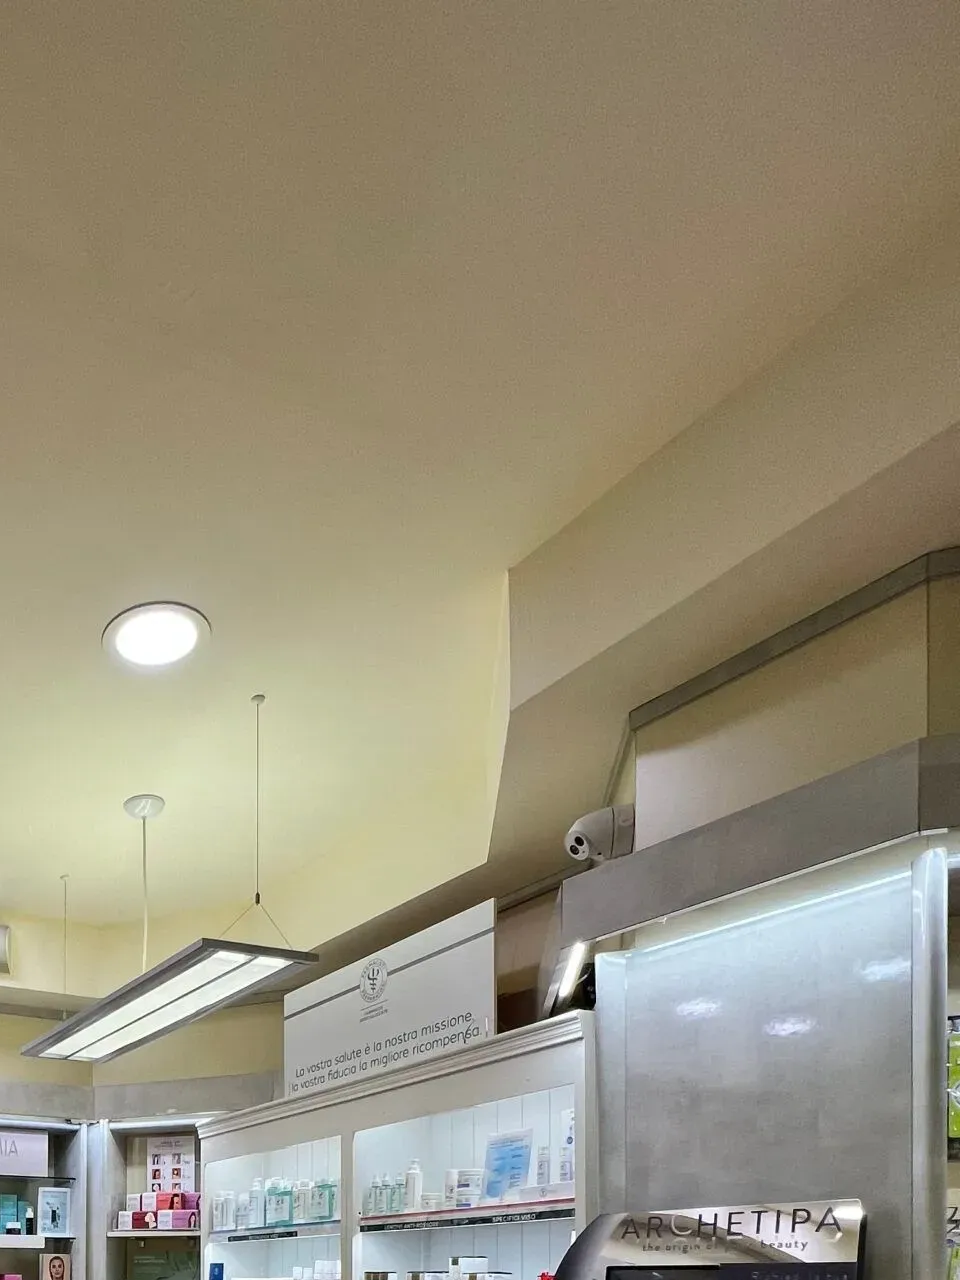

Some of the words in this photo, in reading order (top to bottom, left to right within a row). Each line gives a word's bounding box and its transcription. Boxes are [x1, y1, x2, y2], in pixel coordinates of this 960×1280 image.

[300, 1076, 325, 1090] vostra
[327, 1065, 357, 1082] fiducia
[359, 1060, 368, 1072] la
[370, 1049, 409, 1069] migliore
[306, 1059, 332, 1074] vostra
[334, 1050, 362, 1067] salute
[364, 1043, 371, 1056] è
[373, 1039, 382, 1052] la
[384, 1030, 418, 1048] nostra
[621, 1206, 843, 1240] ARCHETIPA
